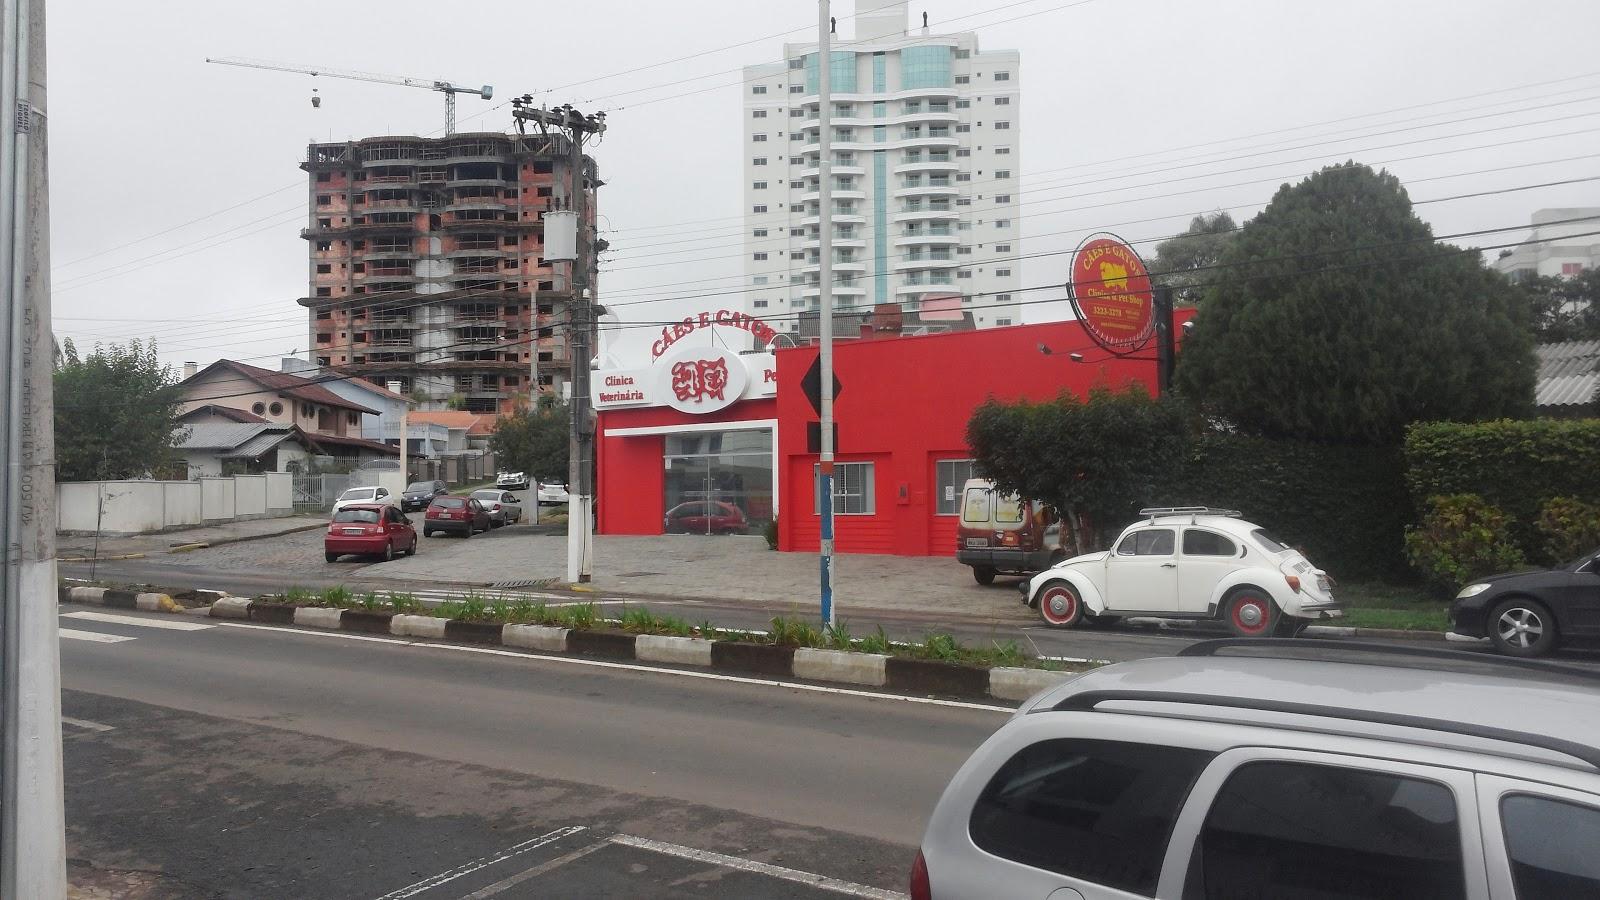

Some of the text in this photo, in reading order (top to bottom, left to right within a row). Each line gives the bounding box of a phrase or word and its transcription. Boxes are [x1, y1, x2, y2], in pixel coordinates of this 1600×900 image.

[1105, 245, 1111, 254] E
[1118, 294, 1129, 303] Pet
[1129, 294, 1144, 308] Shop
[698, 311, 711, 329] E
